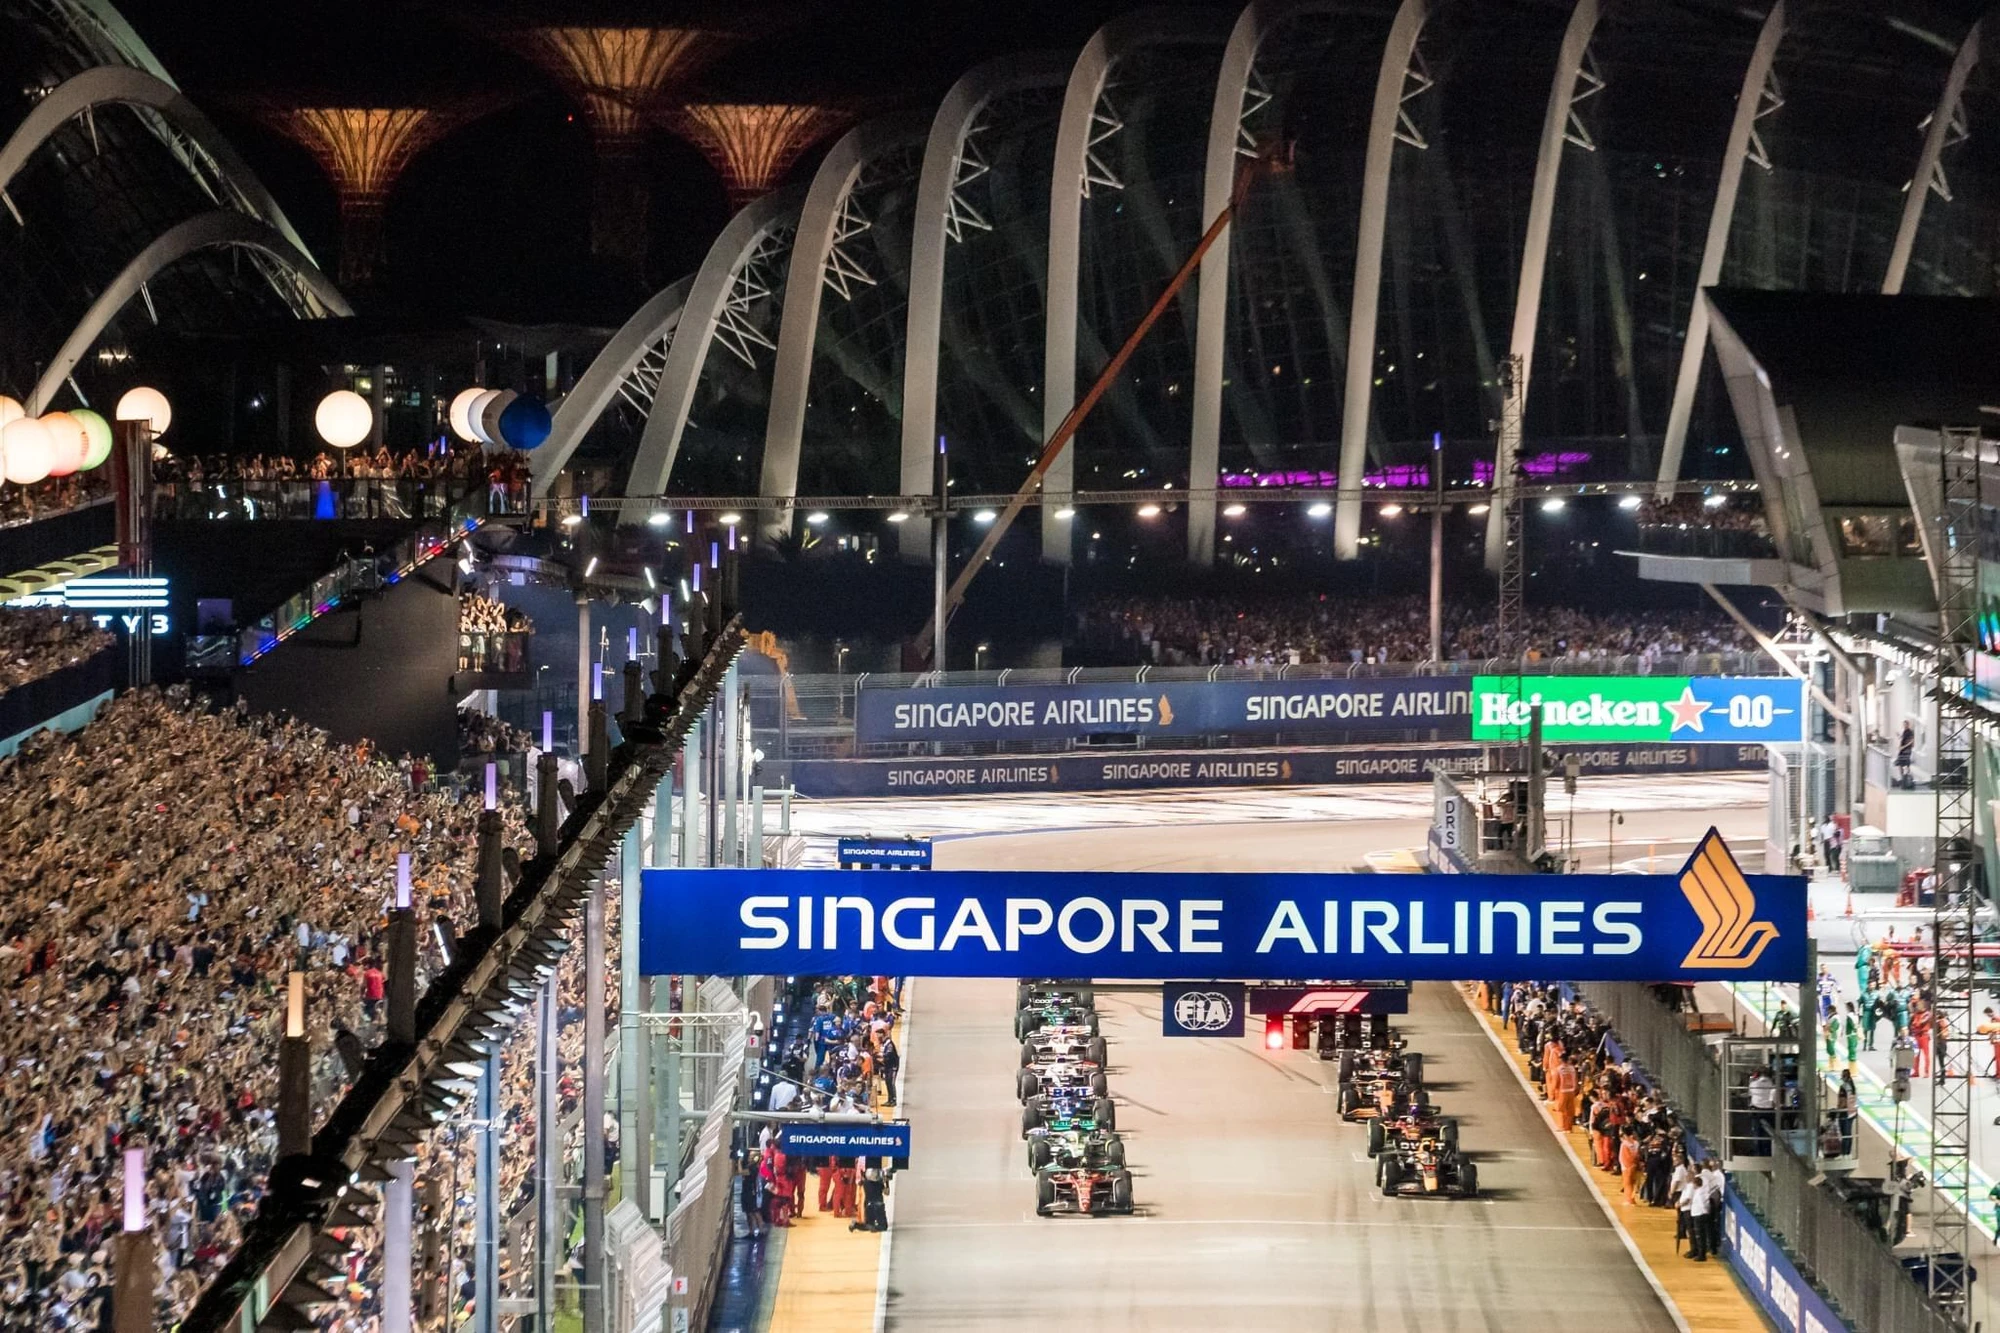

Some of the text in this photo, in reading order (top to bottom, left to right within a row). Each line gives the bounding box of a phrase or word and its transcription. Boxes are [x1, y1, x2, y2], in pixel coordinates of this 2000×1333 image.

[894, 698, 1153, 729] SINGAPORE AIRLINES
[1246, 691, 1473, 721] SINGAPORE AIRLIN
[1625, 748, 1687, 766] AIRLINES
[888, 767, 1048, 786] SINGAPORE AIRLINES
[1102, 761, 1278, 780] SINGAPORE AIRLINES
[1335, 759, 1417, 775] SINGAPORE
[1445, 800, 1455, 845] DRS
[843, 848, 920, 857] SINGAPORE AIRLINES
[739, 896, 1644, 955] SINGAPORE AIRLINES
[1288, 991, 1370, 1013] F1
[789, 1135, 894, 1145] SINGAPORE AIRLINES
